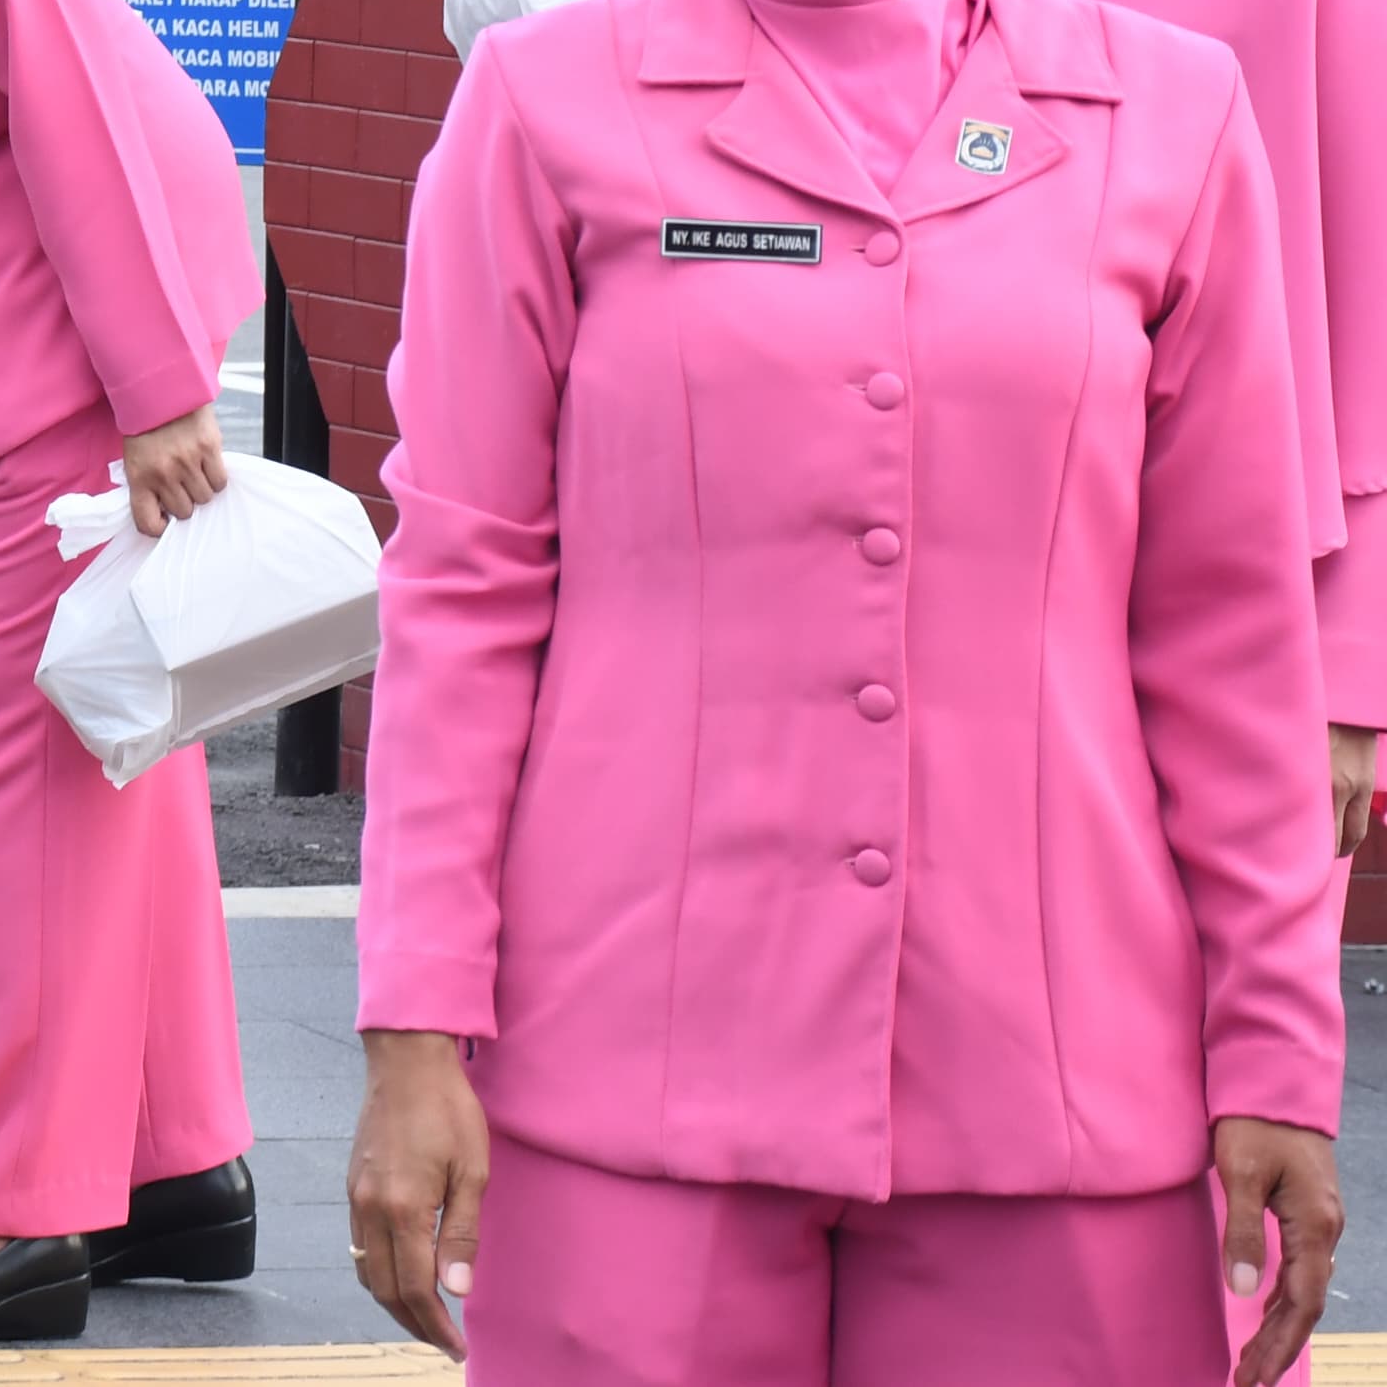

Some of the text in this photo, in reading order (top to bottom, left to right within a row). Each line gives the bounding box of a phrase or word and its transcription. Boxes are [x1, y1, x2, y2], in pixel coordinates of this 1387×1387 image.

[172, 19, 223, 37] KACA
[228, 20, 279, 38] HELM
[173, 49, 223, 67] KACA
[672, 230, 811, 251] NY. IKE AGUS SETIAWAN
